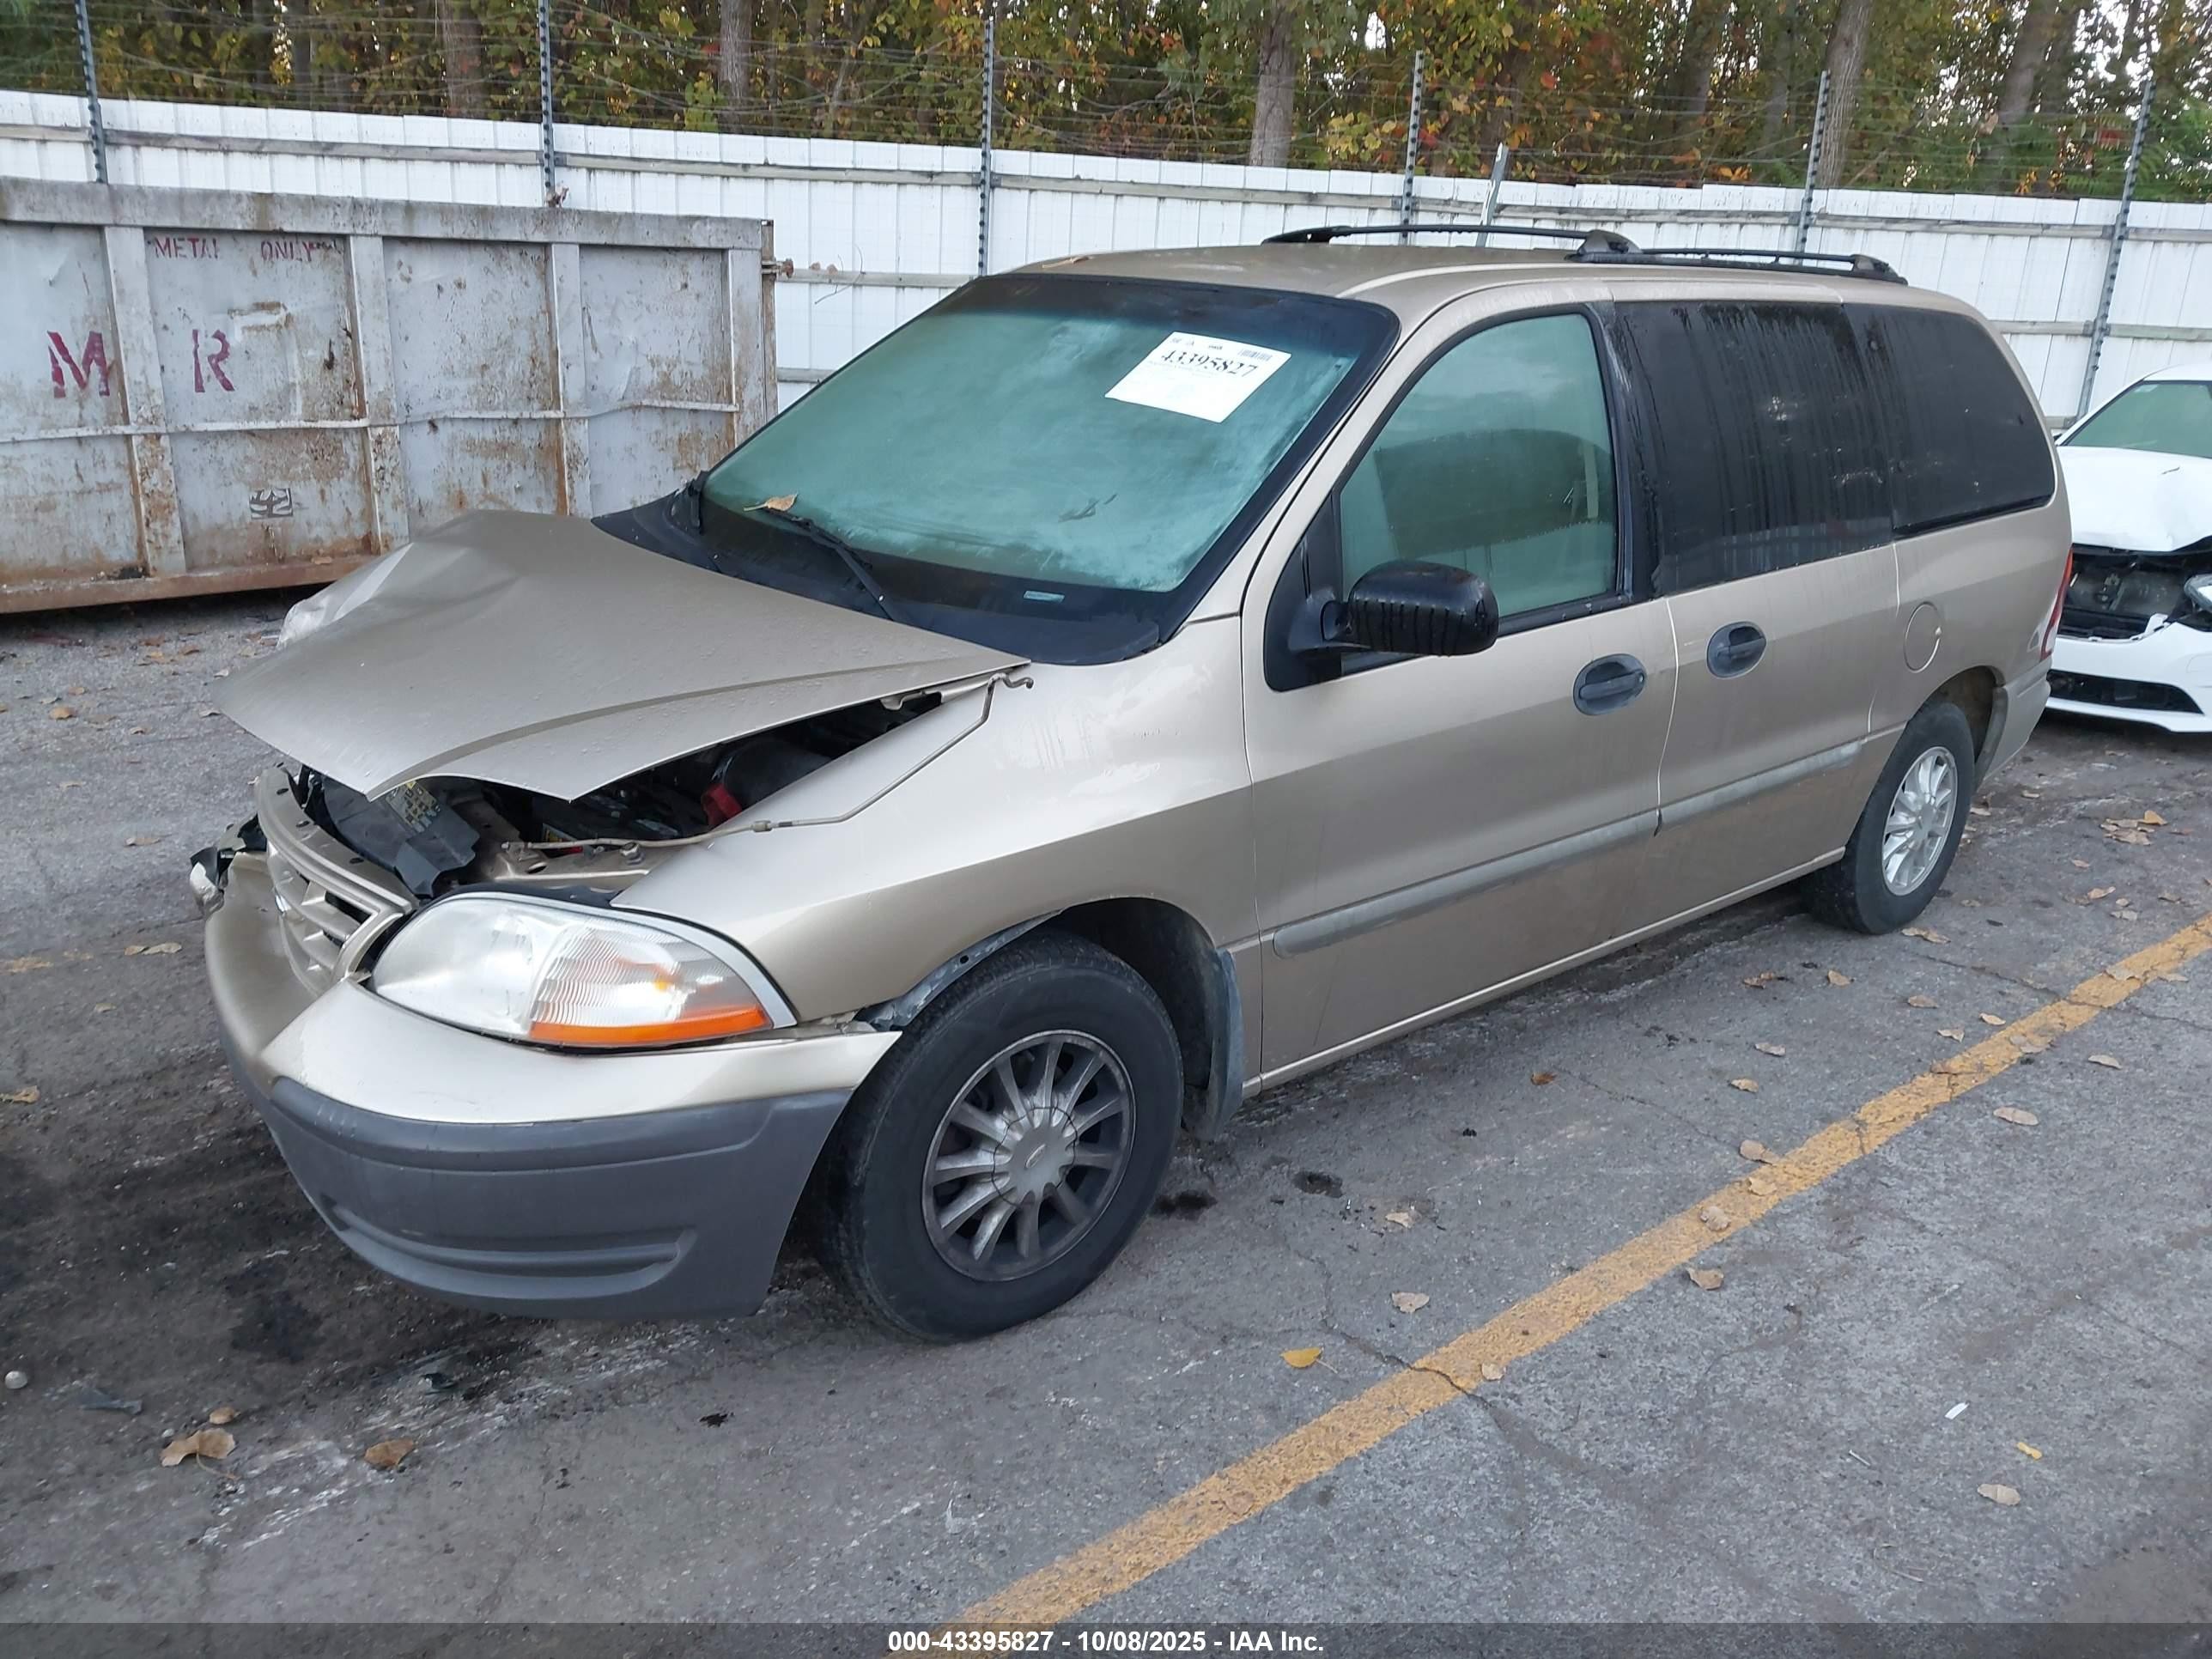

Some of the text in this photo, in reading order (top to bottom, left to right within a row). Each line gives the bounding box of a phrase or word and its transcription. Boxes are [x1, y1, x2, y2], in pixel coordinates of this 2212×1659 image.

[260, 240, 314, 262] ONLY
[46, 329, 236, 399] M R
[1161, 349, 1258, 378] 43395827
